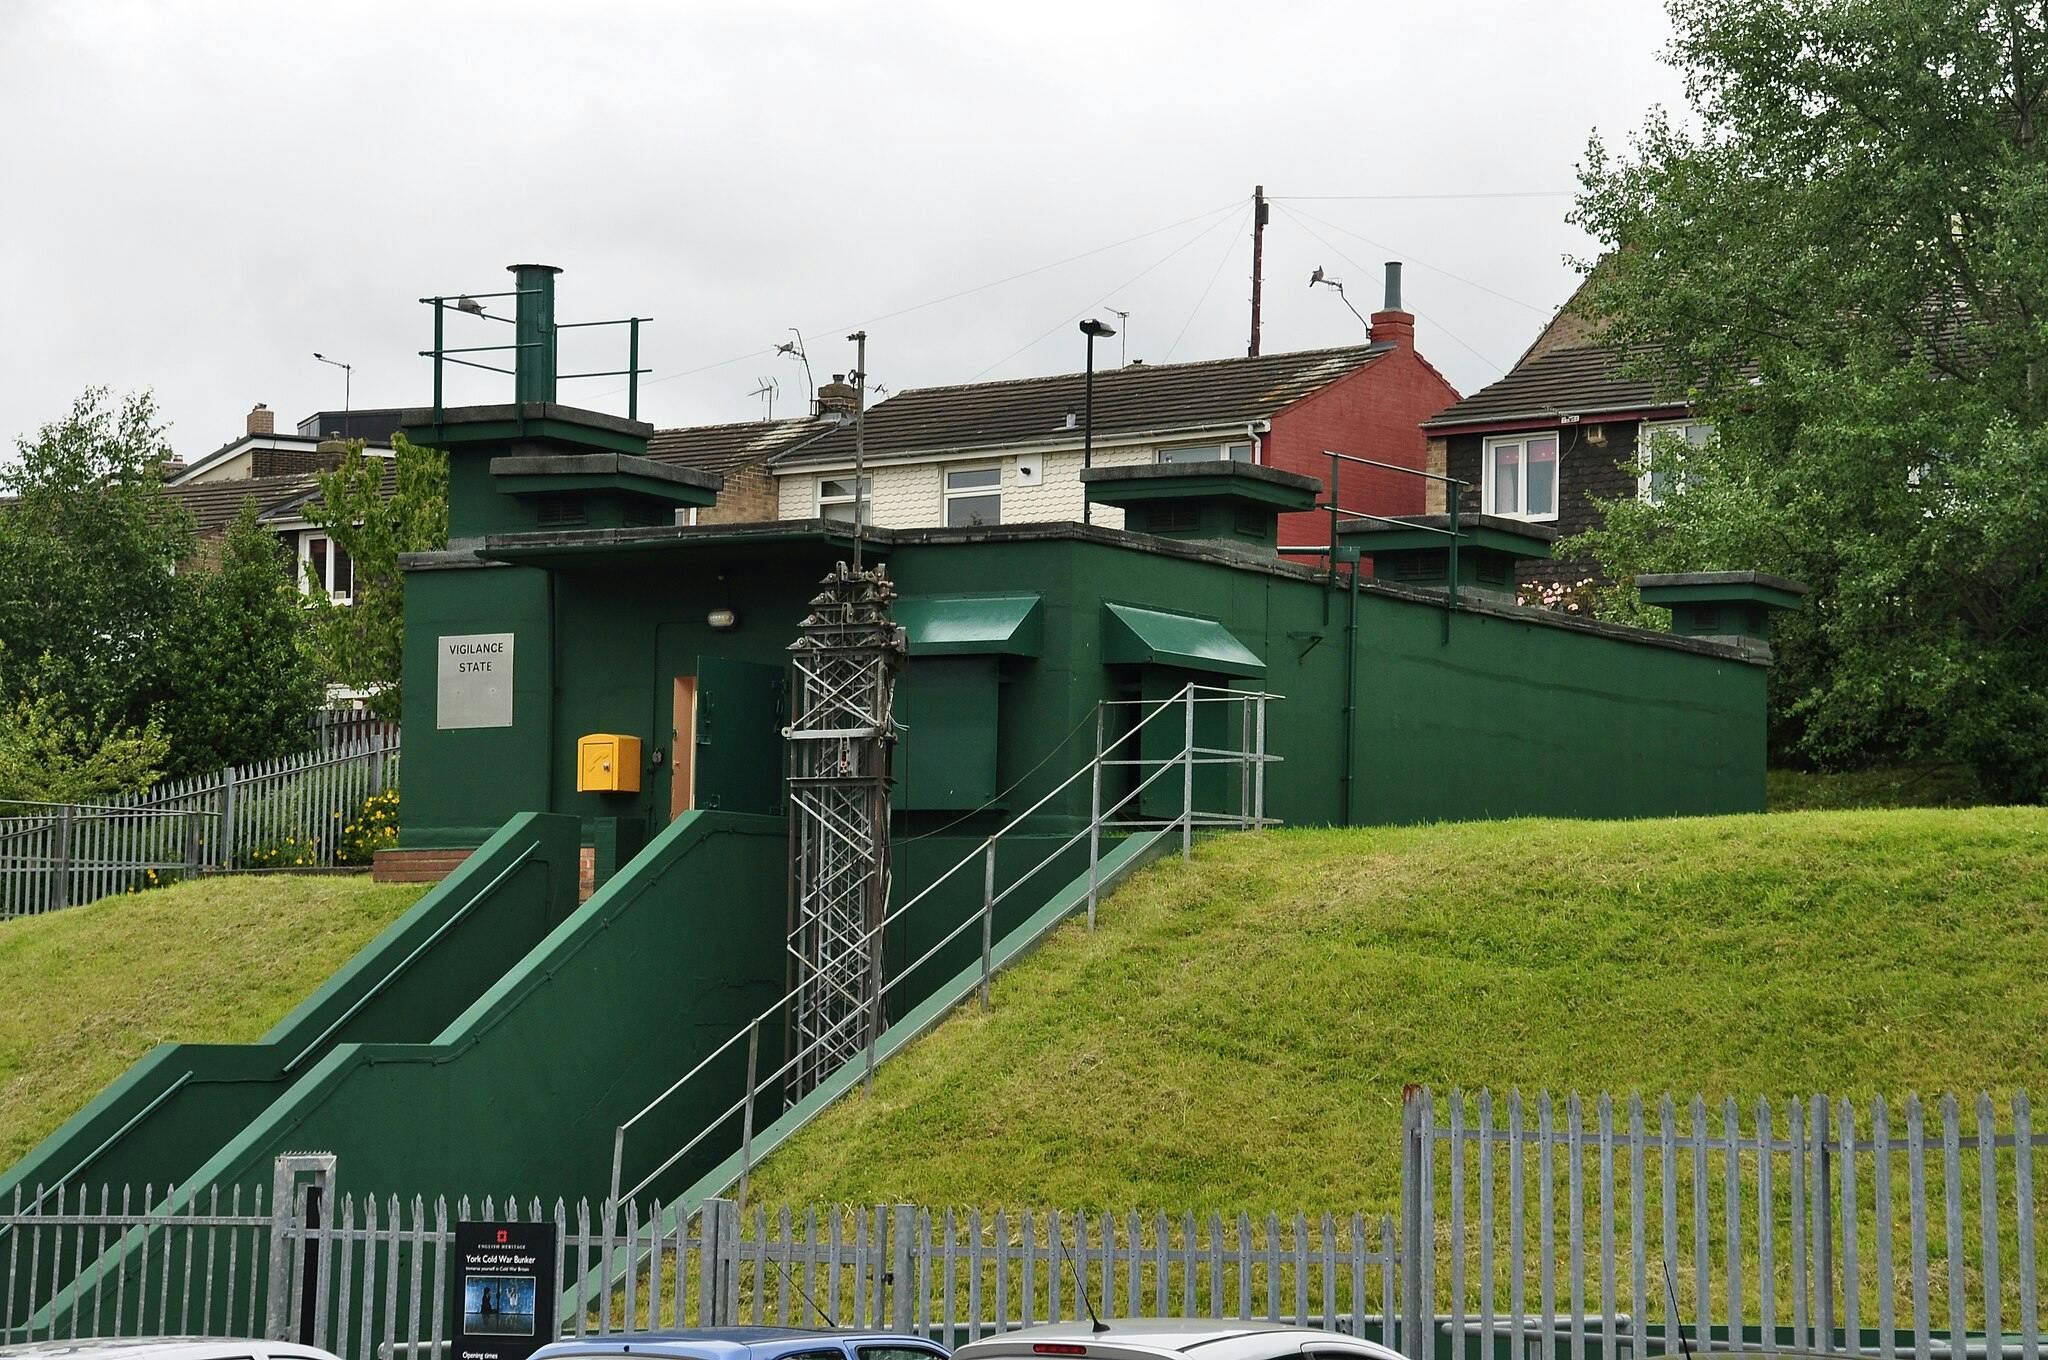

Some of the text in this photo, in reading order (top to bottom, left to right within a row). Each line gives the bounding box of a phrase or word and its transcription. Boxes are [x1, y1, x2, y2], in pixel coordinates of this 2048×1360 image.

[449, 643, 503, 655] VIGILANCE
[459, 662, 492, 673] STATE
[465, 1254, 536, 1264] York Cold War Bunker
[462, 1352, 484, 1360] Opening
